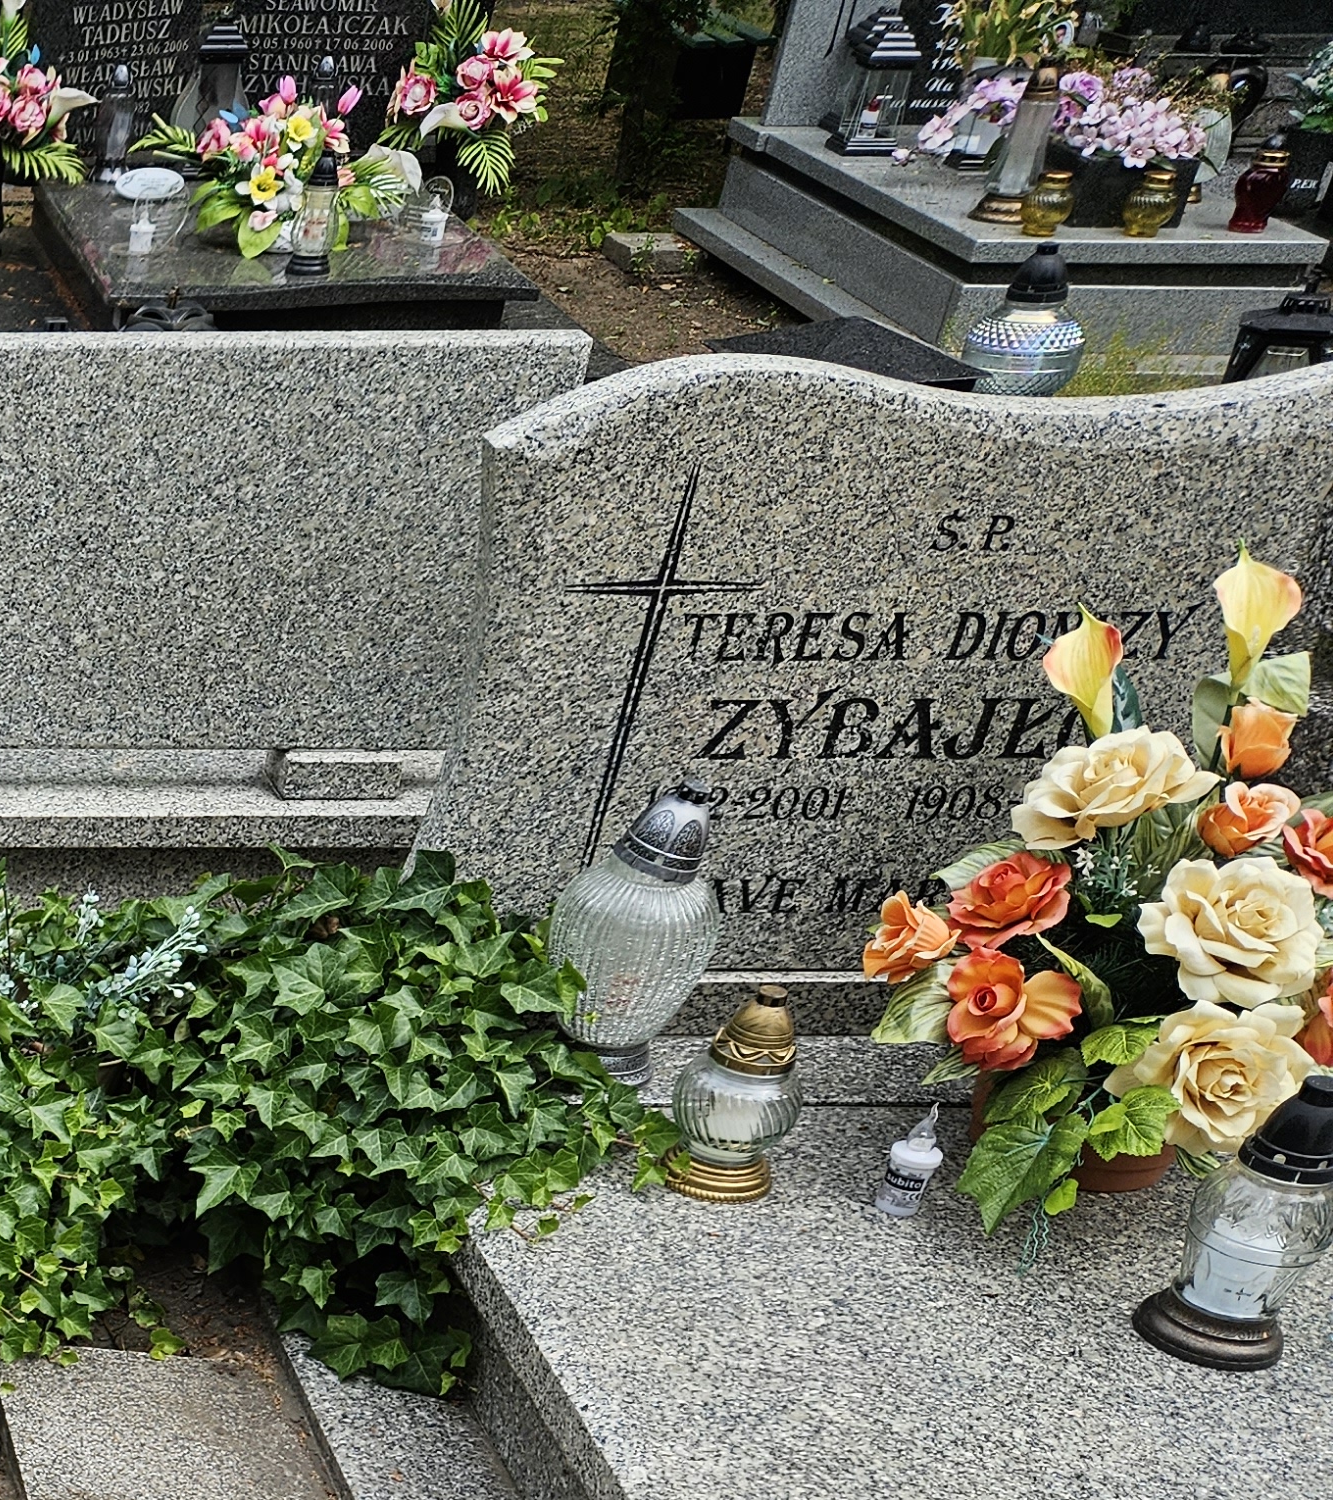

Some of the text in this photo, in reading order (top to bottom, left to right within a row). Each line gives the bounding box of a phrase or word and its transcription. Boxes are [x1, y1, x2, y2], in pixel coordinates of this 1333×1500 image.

[73, 0, 183, 25] WŁADYSŁAW
[239, 14, 410, 35] MIKOŁAJCZAK
[82, 19, 172, 47] TADEUSZ
[66, 57, 177, 84] WŁADSŁAW
[249, 53, 377, 73] STANISAWA
[683, 600, 1207, 665] TERESA DIOZY
[887, 1173, 922, 1189] subito
